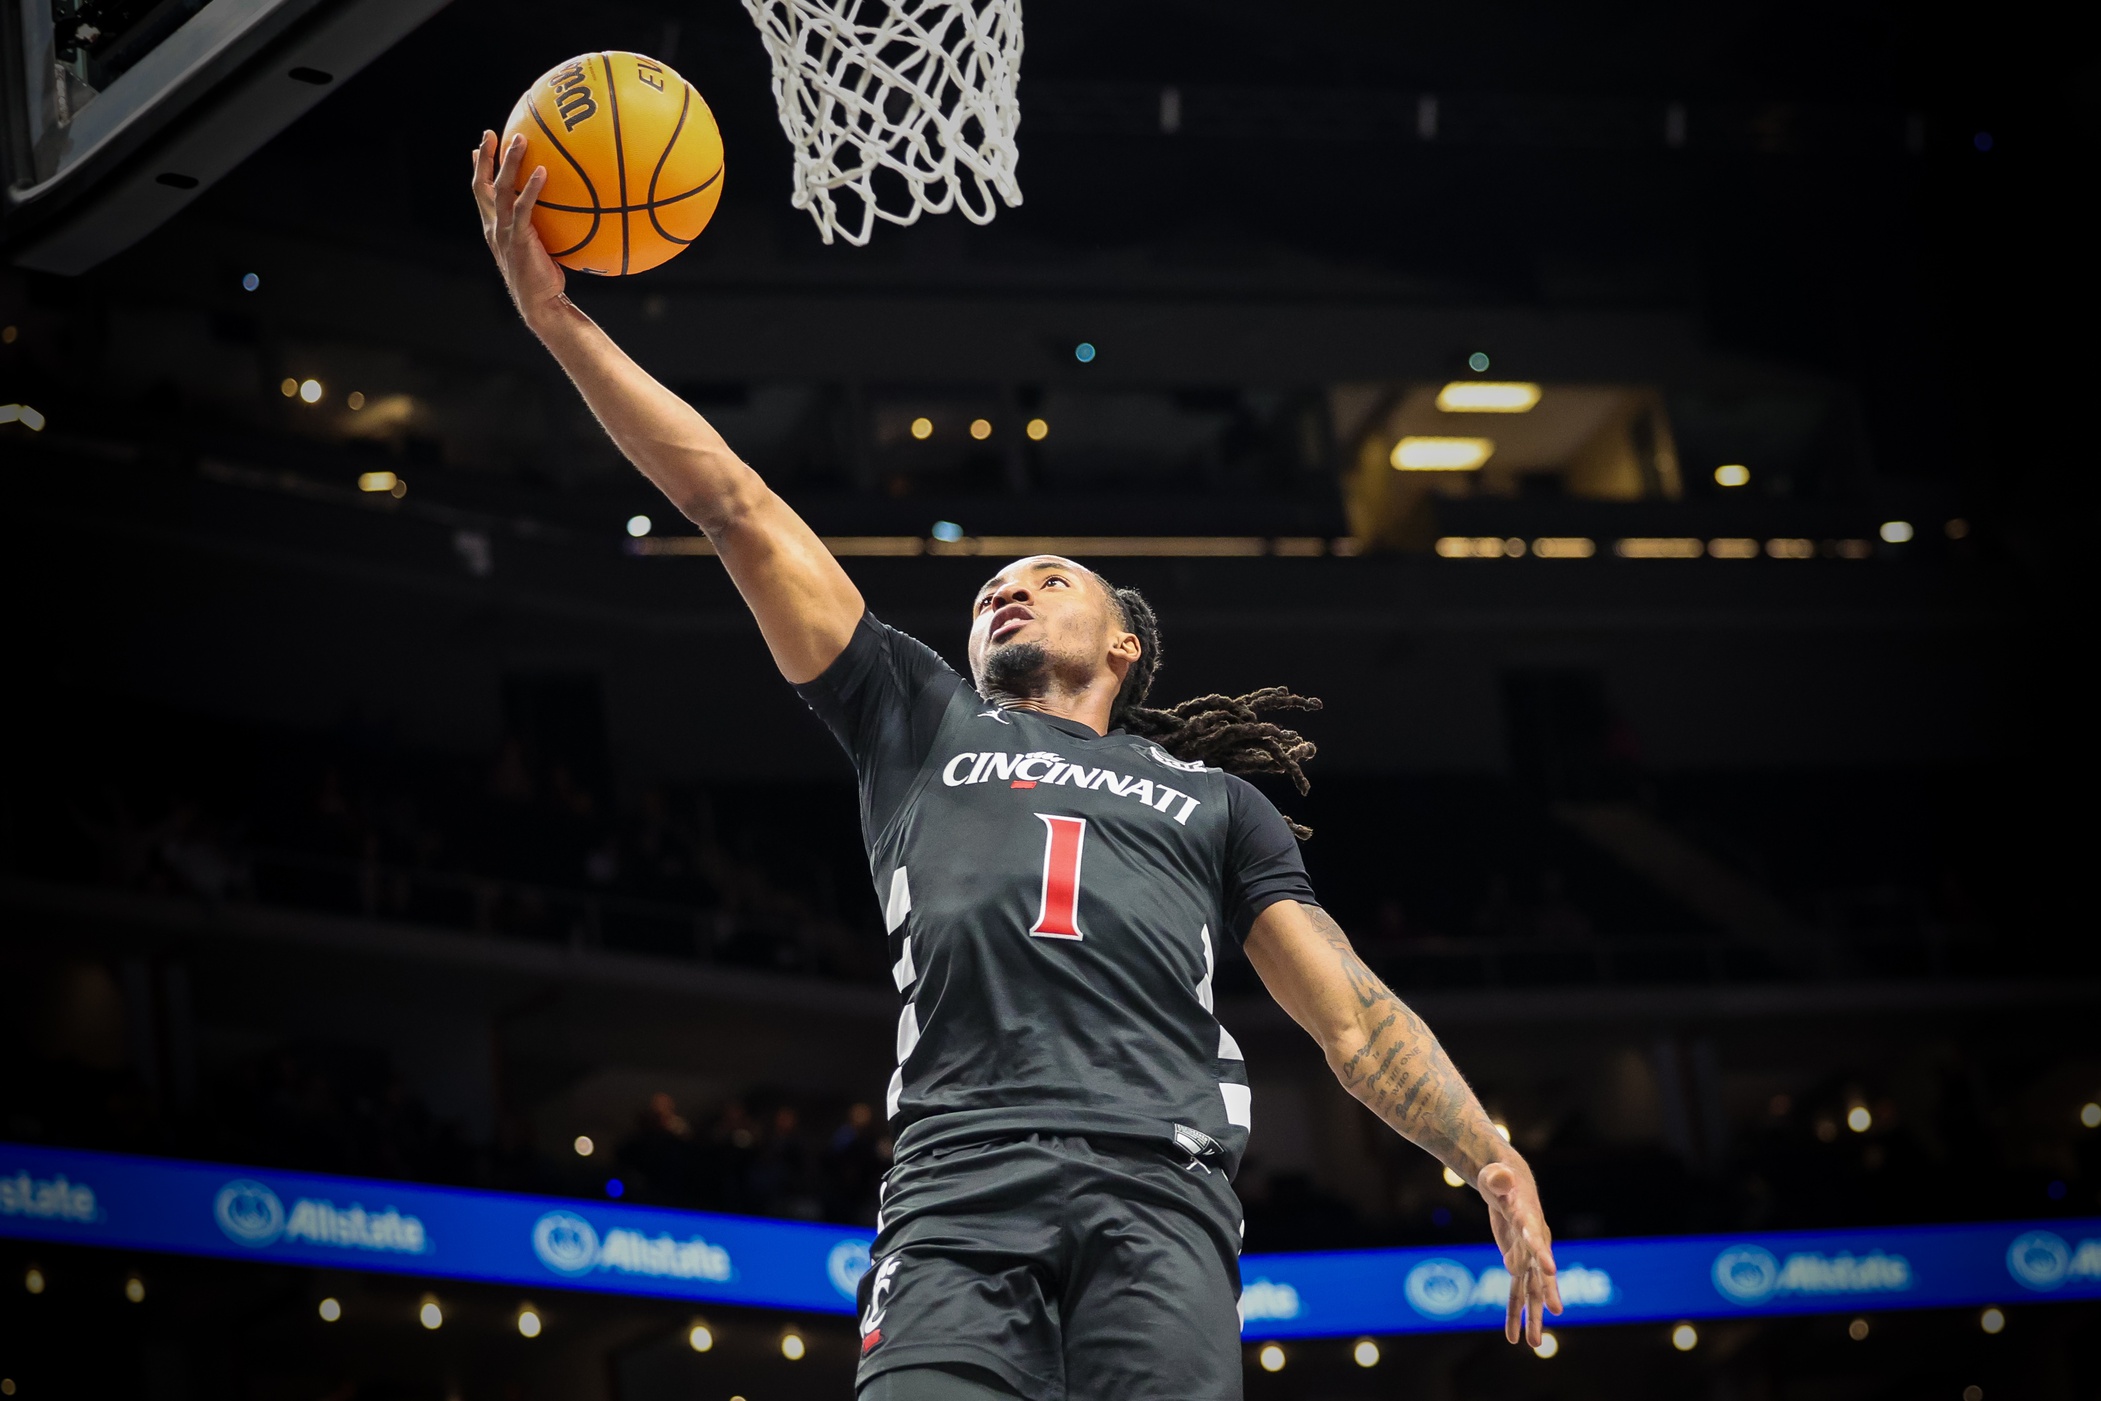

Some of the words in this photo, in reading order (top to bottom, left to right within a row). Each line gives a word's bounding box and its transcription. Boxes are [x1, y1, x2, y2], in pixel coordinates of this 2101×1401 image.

[942, 752, 1201, 826] CINCINNATI
[1029, 812, 1087, 941] 1
[1400, 1046, 1422, 1066] ONE
